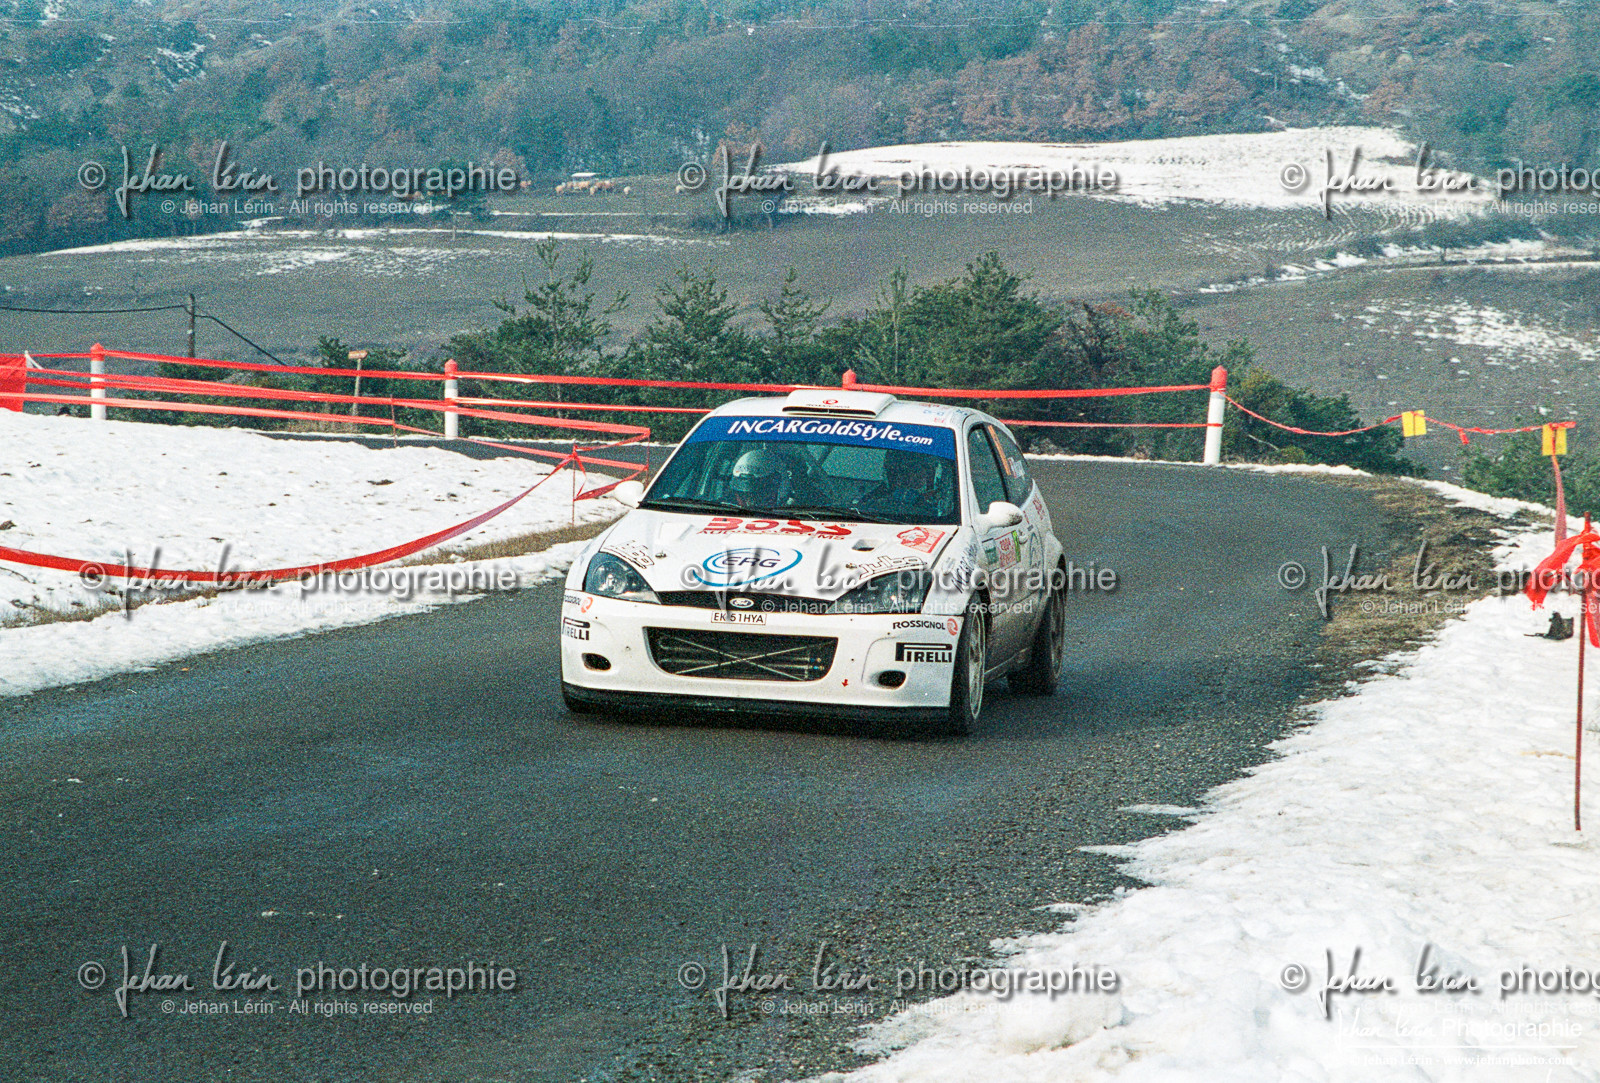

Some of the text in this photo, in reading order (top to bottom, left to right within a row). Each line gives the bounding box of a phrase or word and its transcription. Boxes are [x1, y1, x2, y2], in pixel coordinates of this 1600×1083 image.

[727, 418, 933, 446] INCARGoldStyle.com
[722, 556, 781, 568] ERG
[713, 612, 764, 623] EK 51HYA
[892, 620, 946, 630] ROSSIGNOL
[895, 642, 953, 663] PIRELLI
